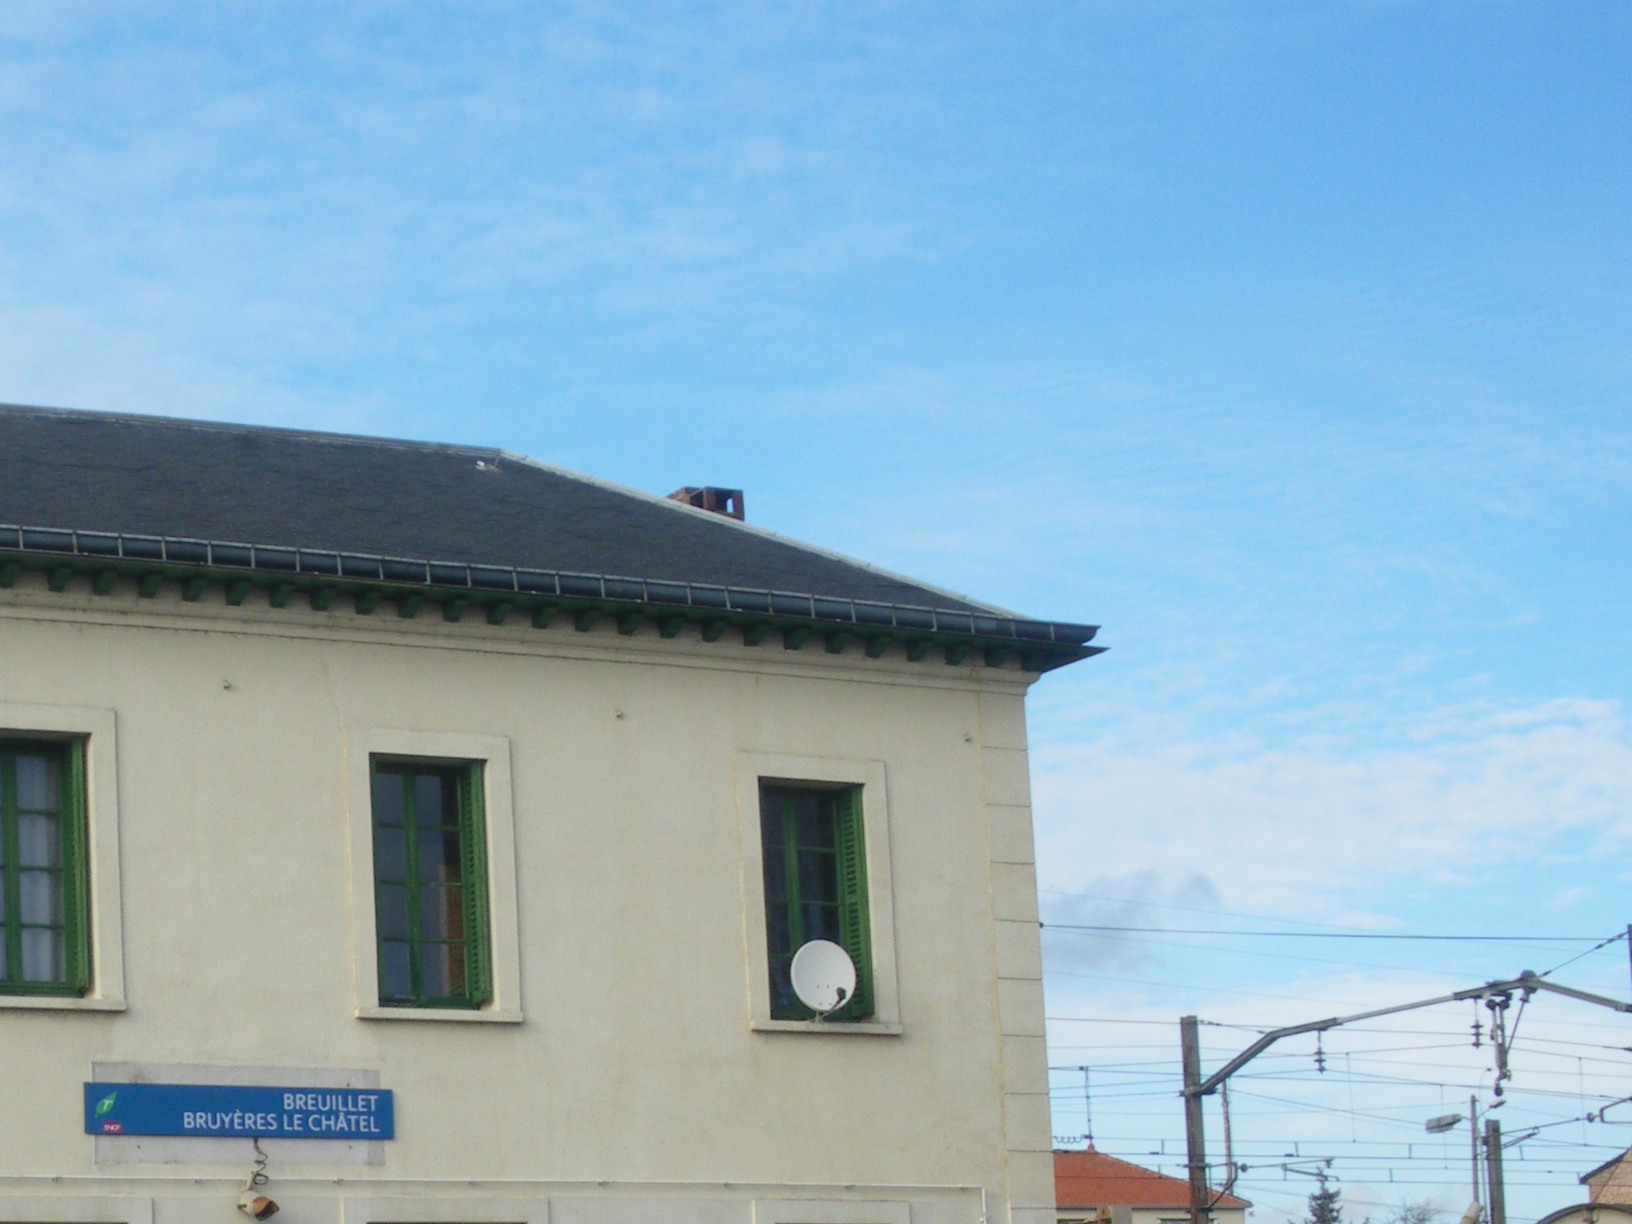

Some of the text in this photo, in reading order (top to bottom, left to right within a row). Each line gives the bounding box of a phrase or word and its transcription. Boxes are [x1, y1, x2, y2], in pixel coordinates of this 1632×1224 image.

[283, 1093, 379, 1113] BREUILLET
[183, 1109, 380, 1133] BRUYÈRES LE CHÂTEL
